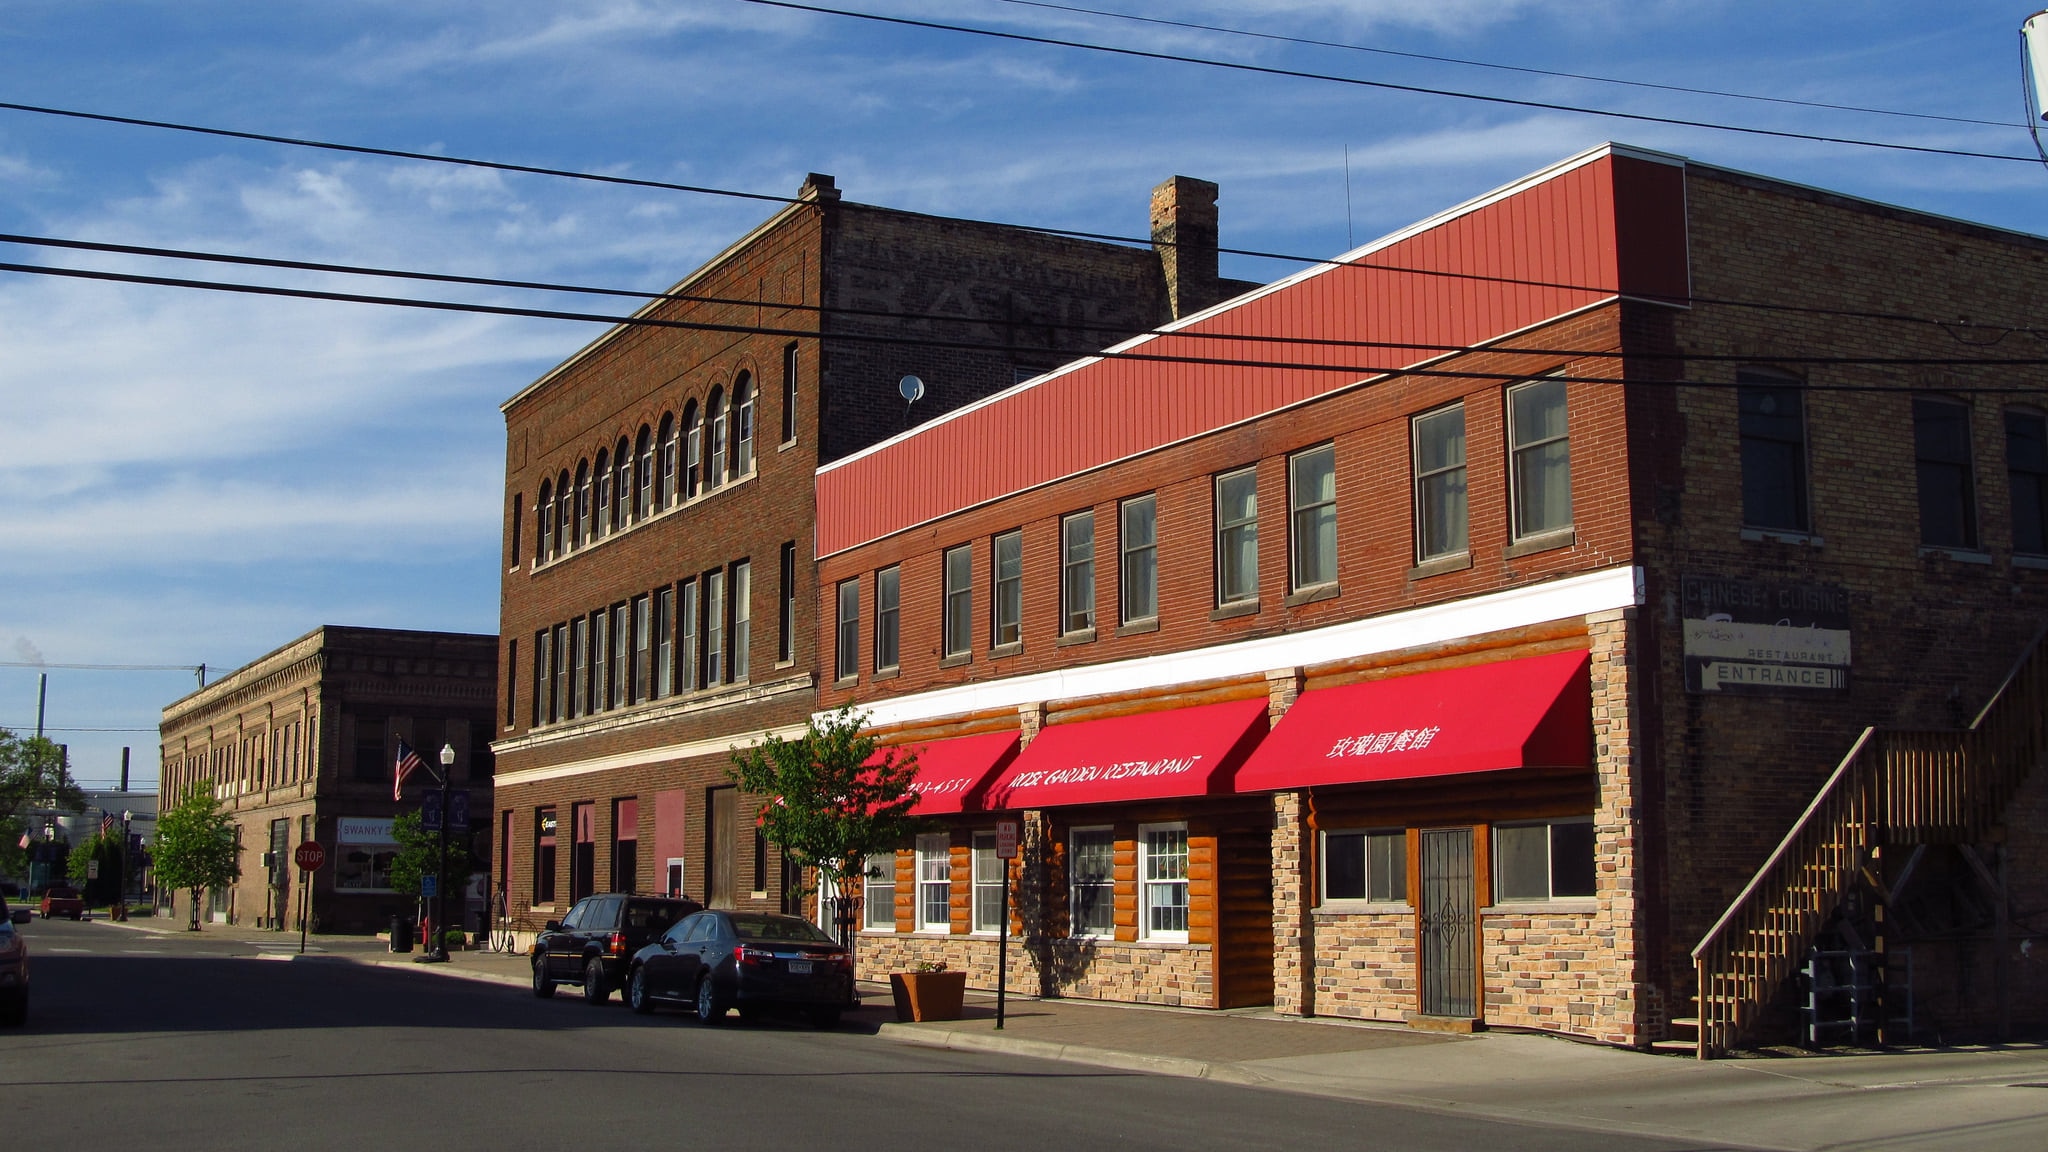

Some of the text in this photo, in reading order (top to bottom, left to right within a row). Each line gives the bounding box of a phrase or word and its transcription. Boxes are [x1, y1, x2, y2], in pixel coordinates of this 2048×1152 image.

[1686, 580, 1847, 614] CHINESE CUISINE
[1747, 648, 1834, 663] RESTAURANT
[1717, 665, 1826, 685] ENTRANCE
[1326, 725, 1441, 759] 玫瑰園餐館
[1008, 755, 1203, 788] ROSE GARDEN RESTAURANT
[343, 824, 383, 836] SWANKY
[296, 849, 323, 863] STOP
